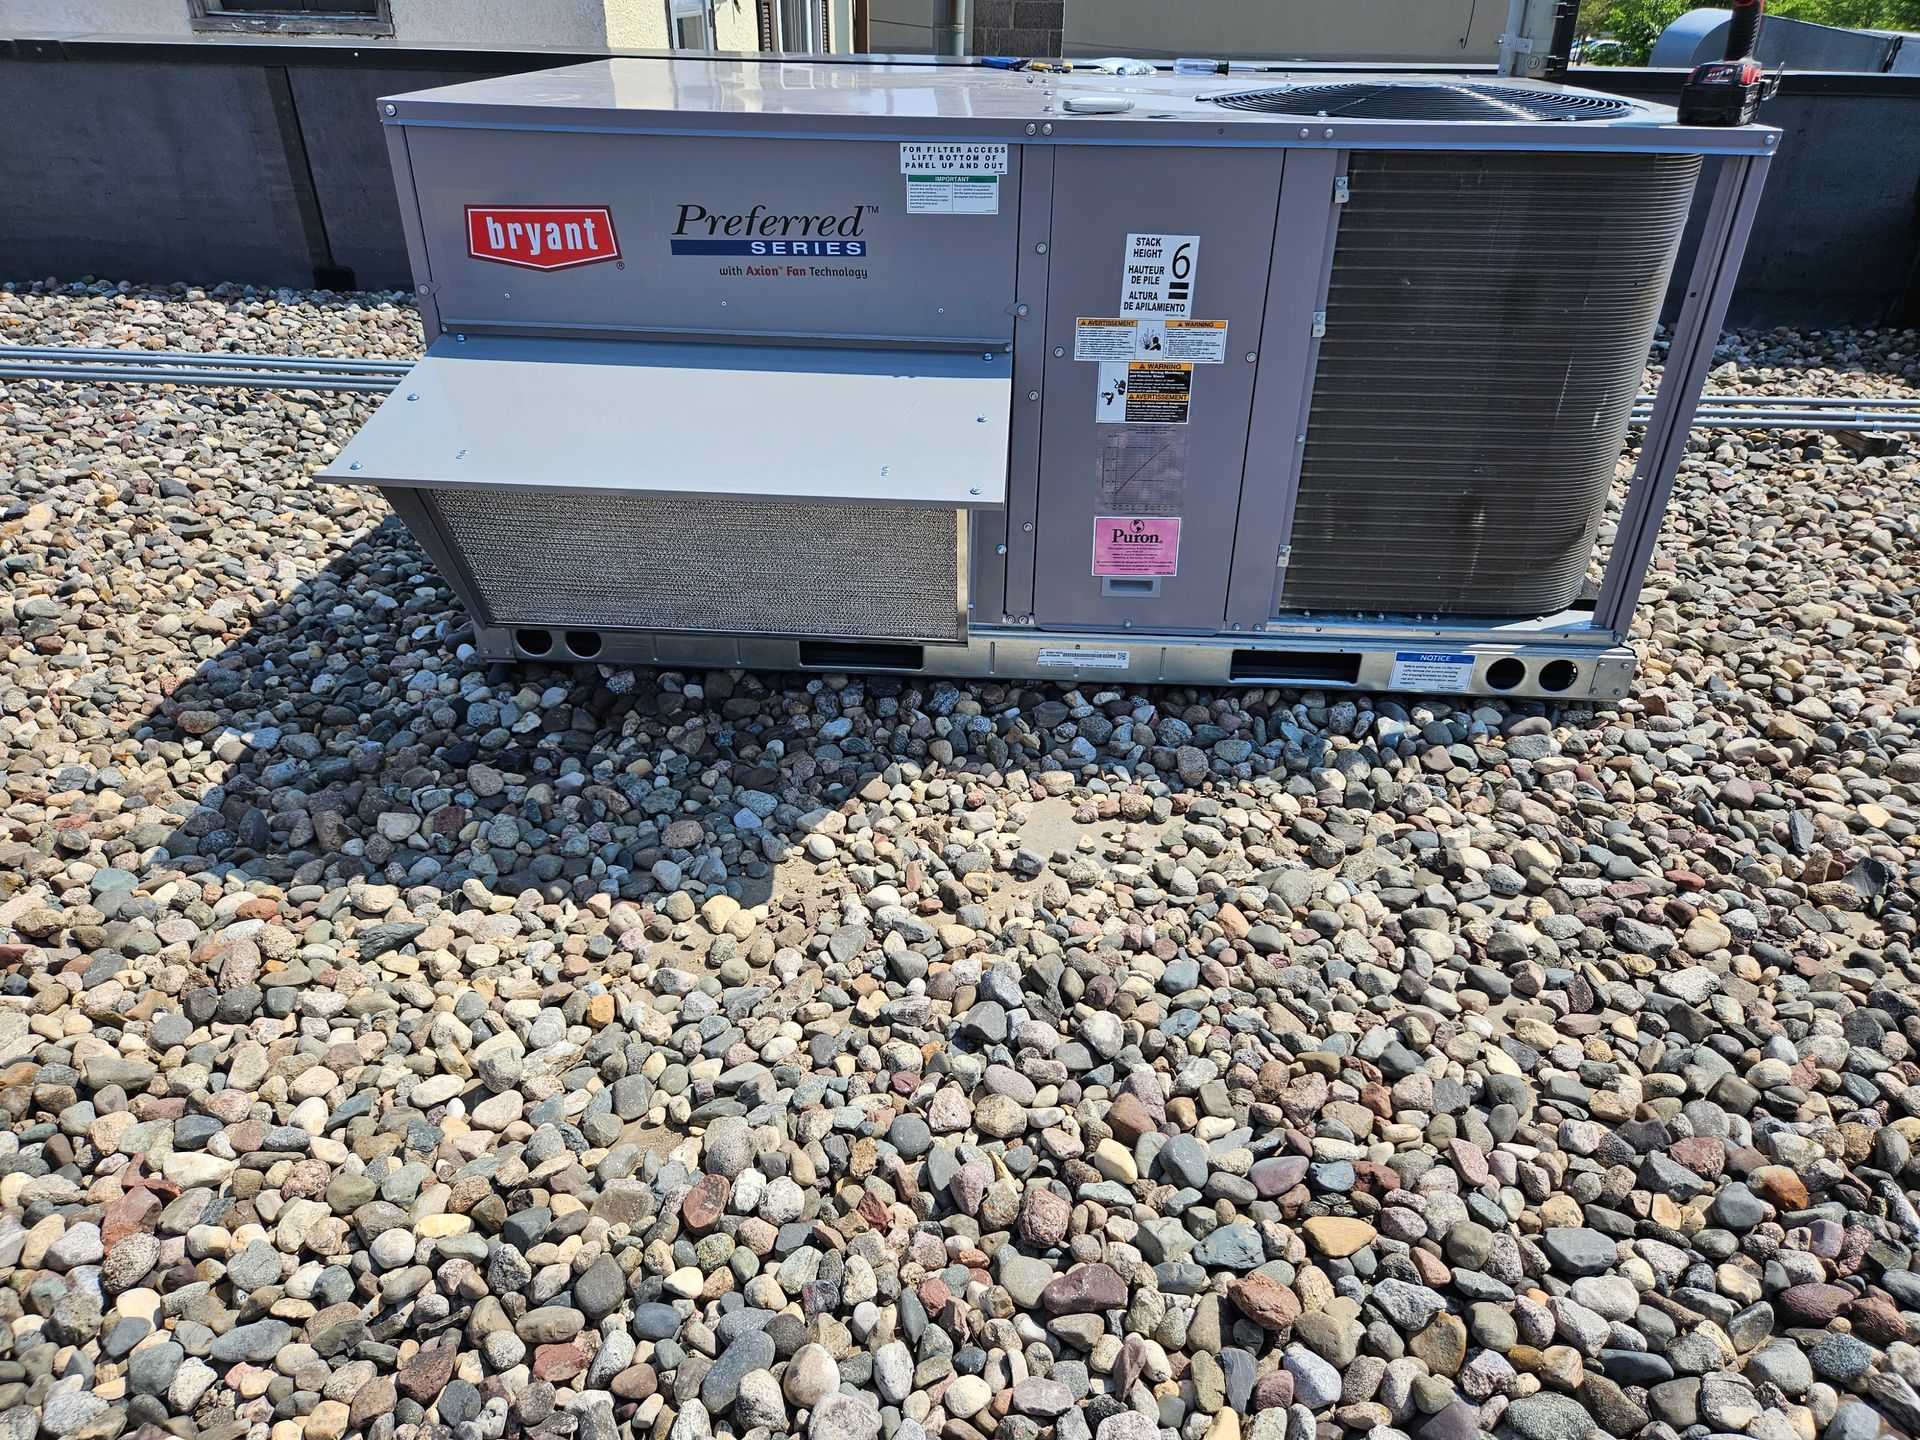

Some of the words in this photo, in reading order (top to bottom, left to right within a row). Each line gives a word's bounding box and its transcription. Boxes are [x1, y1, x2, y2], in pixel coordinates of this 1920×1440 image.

[671, 204, 864, 237] Preferred
[486, 216, 598, 256] bryant
[1136, 237, 1162, 247] STACK
[750, 241, 862, 255] SERIES
[1133, 249, 1163, 258] HEIGHT
[1172, 242, 1191, 280] 6
[719, 266, 743, 276] with
[786, 266, 806, 276] Fan
[809, 266, 868, 280] Technology
[1128, 265, 1165, 275] HAUTEUR
[1131, 276, 1142, 284] DE
[1143, 276, 1160, 285] PILE
[1129, 291, 1158, 300] ALTURA
[1124, 302, 1134, 310] DE
[1135, 302, 1186, 312] APILAMIENTO
[1112, 528, 1159, 544] Puron
